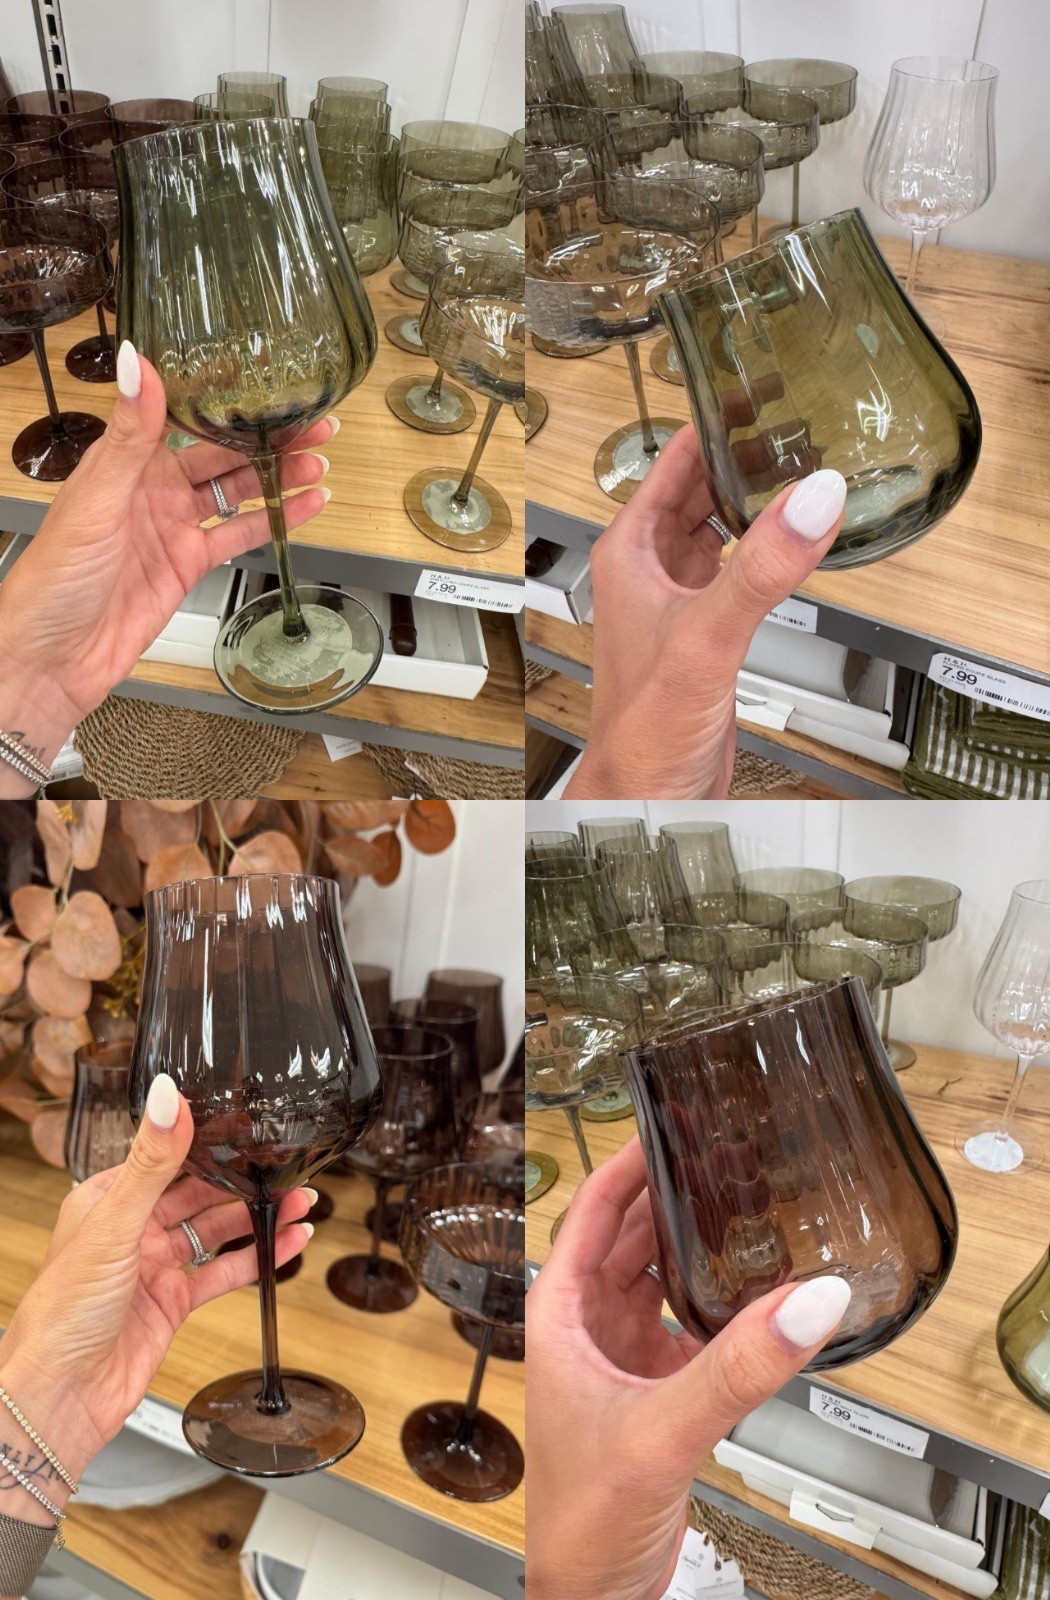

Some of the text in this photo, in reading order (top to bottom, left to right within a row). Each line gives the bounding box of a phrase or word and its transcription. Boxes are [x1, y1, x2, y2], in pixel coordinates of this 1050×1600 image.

[428, 581, 456, 593] 7.99
[942, 665, 977, 685] 7.99
[822, 1401, 851, 1420] 7.99
